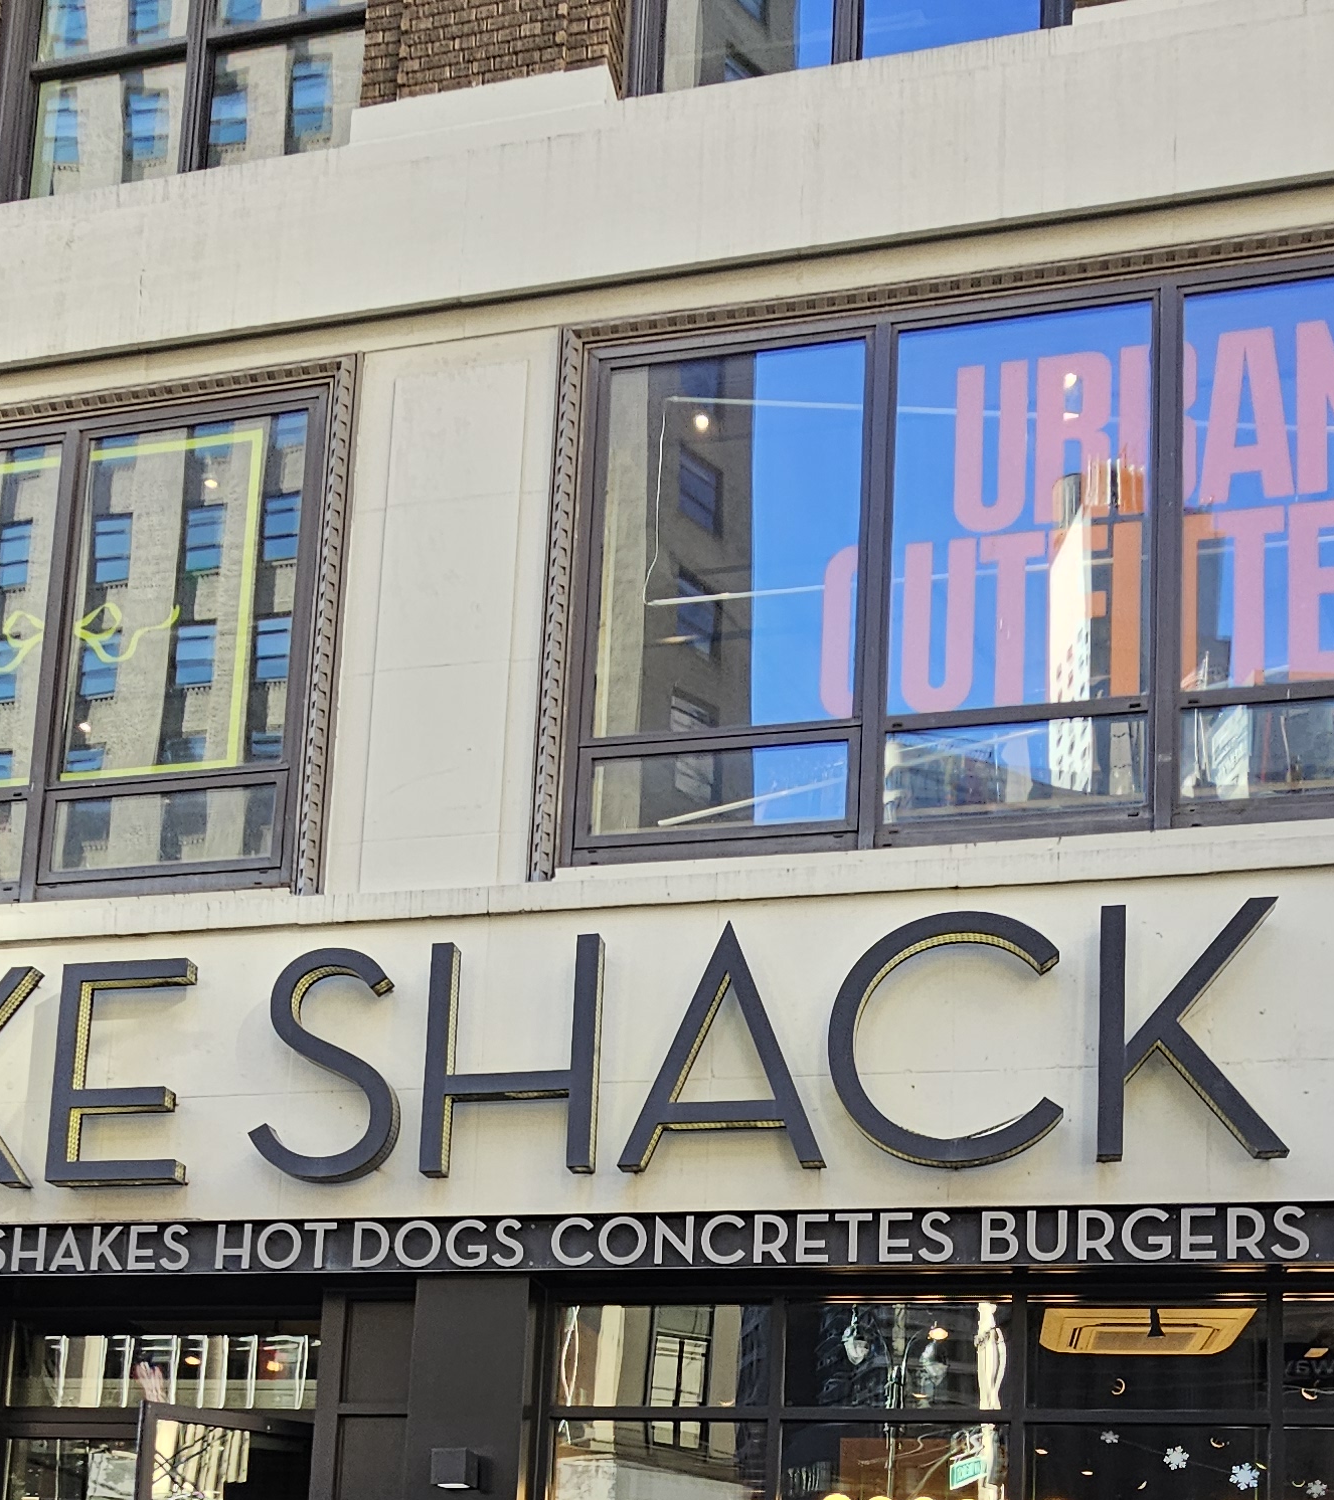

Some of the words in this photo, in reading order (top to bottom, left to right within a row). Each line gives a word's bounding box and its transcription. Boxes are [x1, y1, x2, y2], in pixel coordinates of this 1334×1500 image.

[247, 895, 1291, 1188] SHACK
[214, 1222, 337, 1271] HOT
[353, 1218, 523, 1269] DOGS
[550, 1210, 952, 1267] CONCRETES
[980, 1205, 1311, 1263] BURGERS
